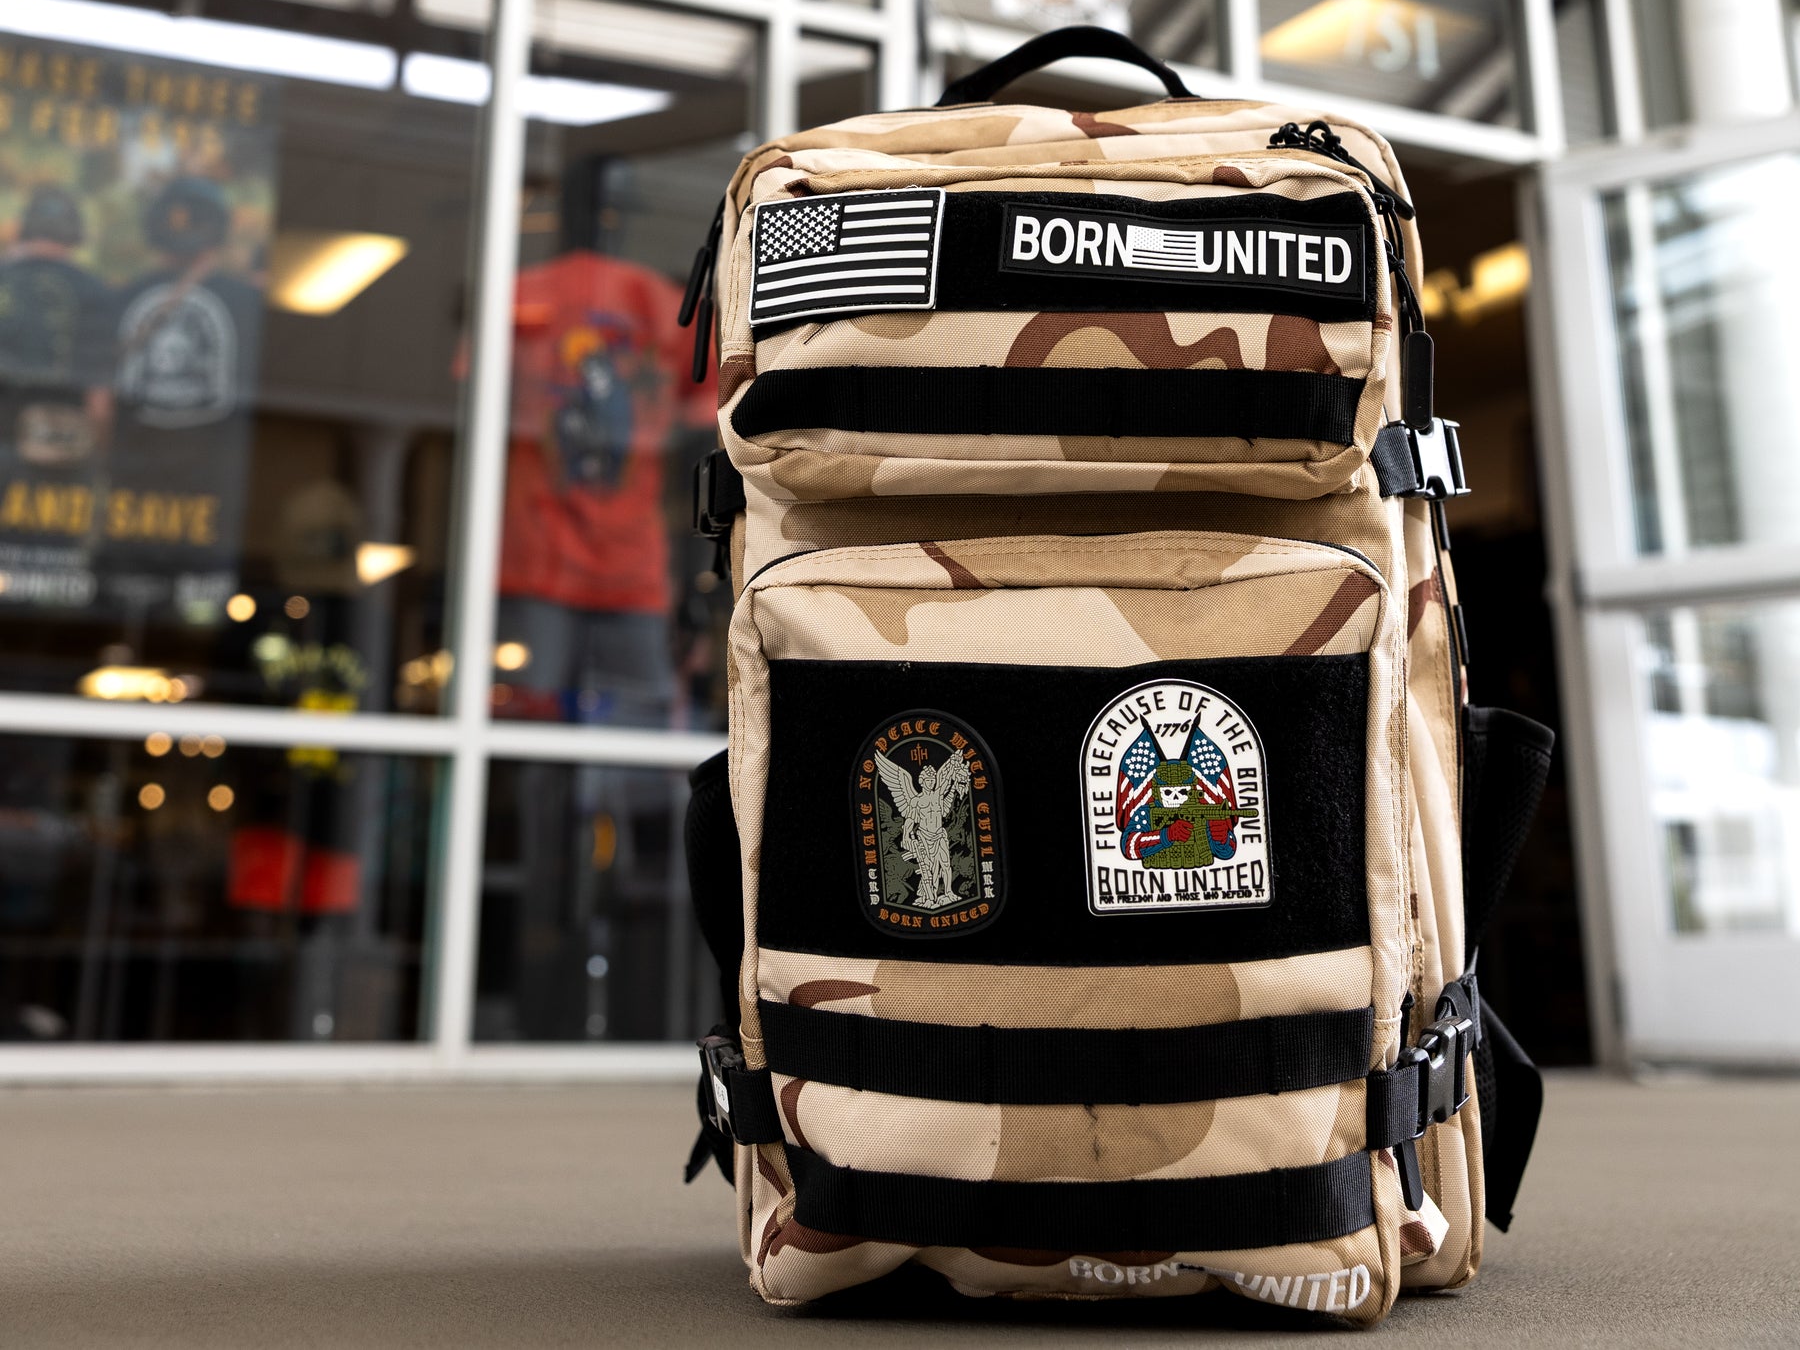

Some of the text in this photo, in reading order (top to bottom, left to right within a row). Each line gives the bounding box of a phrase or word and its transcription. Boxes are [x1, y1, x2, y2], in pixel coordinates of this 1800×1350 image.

[1012, 215, 1352, 284] BORN UNITED
[0, 480, 219, 547] AND SAVE
[859, 759, 876, 790] NO
[874, 719, 941, 753] PEACE
[949, 731, 988, 790] WITH
[1154, 719, 1192, 737] 1776
[1090, 690, 1262, 850] FREE BECAUSE OF THE BRAVE
[1097, 859, 1264, 896] BORN UNITED
[1117, 893, 1154, 904] FREEDOM
[1156, 893, 1173, 903] AND
[1174, 892, 1201, 902] THOSE
[1254, 888, 1266, 898] IT
[878, 908, 923, 928] BORN
[1069, 1257, 1371, 1312] BORN UNITED
